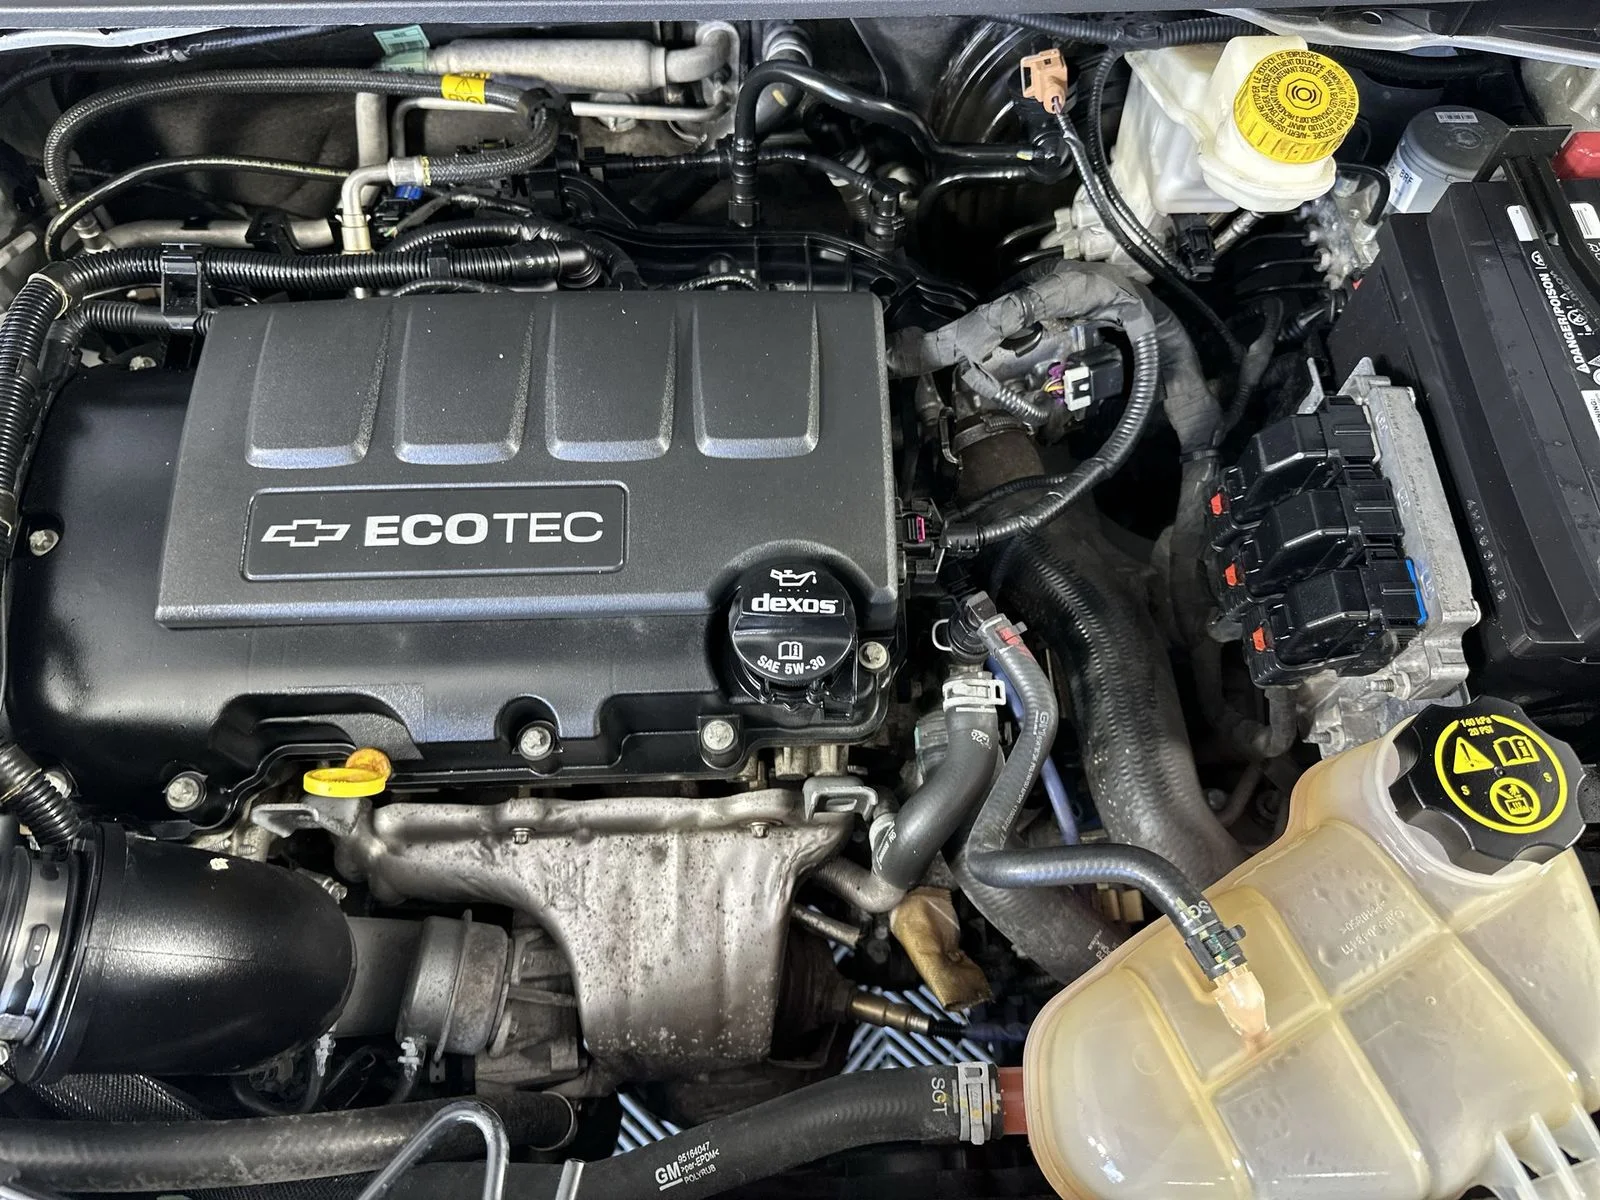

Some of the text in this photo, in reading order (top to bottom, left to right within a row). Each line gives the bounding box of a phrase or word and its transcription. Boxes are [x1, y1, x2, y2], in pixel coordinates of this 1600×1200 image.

[1334, 119, 1349, 132] CAP
[1539, 273, 1586, 364] DANGER/POISON
[364, 510, 604, 546] ECOTEC
[751, 592, 838, 614] dexos
[758, 655, 826, 674] SAE 5W-30
[1460, 718, 1476, 728] 140
[1468, 725, 1494, 736] 20 PSI
[678, 1141, 710, 1164] 95164047
[655, 1161, 682, 1184] GM
[684, 1164, 716, 1184] POLYRUB
